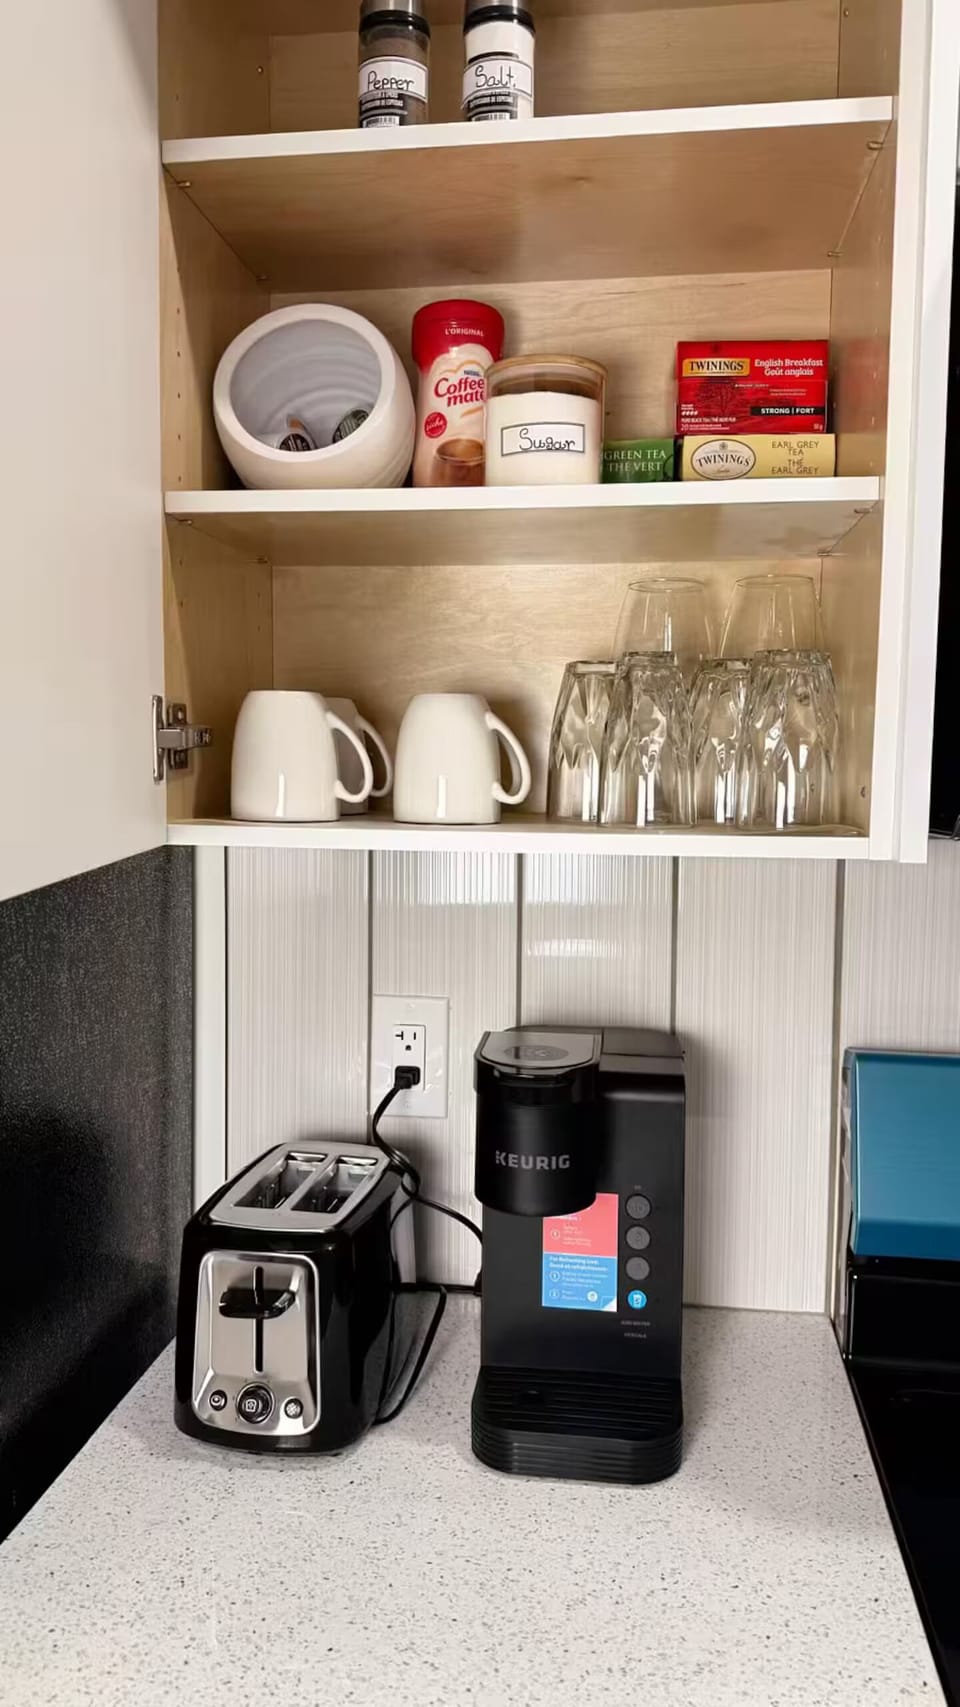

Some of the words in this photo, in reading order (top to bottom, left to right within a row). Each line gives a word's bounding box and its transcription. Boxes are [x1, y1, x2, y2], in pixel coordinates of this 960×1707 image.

[367, 70, 415, 91] Pepper
[445, 328, 484, 337] L'ORIGINAL
[690, 360, 744, 371] TWININGS
[755, 359, 783, 368] English
[784, 358, 823, 367] Breakfast
[764, 367, 783, 376] Goût
[784, 367, 814, 377] anglais
[434, 377, 485, 398] Coffee
[796, 407, 815, 415] FORT
[519, 427, 576, 451] Sugar
[771, 441, 793, 449] EARL
[796, 440, 820, 449] GREY
[604, 450, 642, 460] GREEN
[646, 449, 667, 459] TEA
[788, 448, 805, 456] TEA
[696, 454, 750, 467] TWININGS
[633, 461, 663, 472] VERT
[771, 466, 793, 475] EARL
[796, 466, 820, 475] GREY
[495, 1150, 570, 1170] KEURIG
